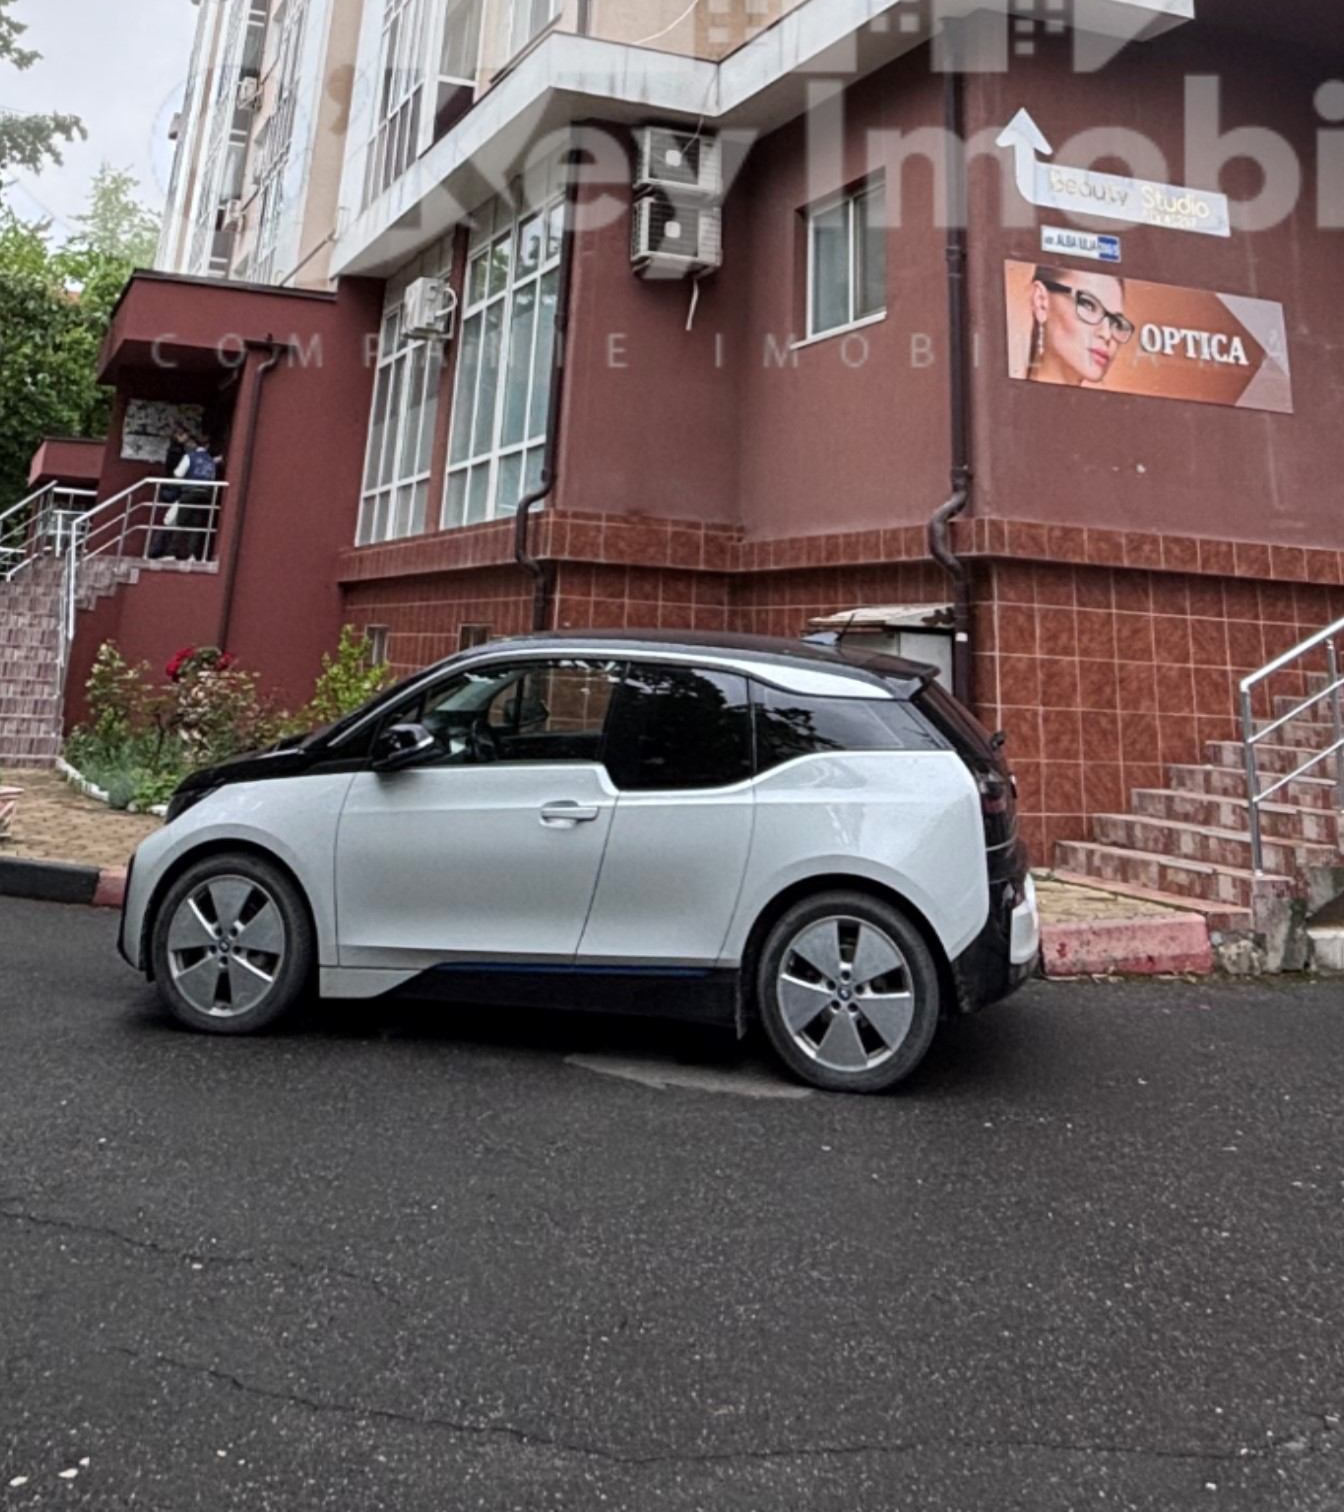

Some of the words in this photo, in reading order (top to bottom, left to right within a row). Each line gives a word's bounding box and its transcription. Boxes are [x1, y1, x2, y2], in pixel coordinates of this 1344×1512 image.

[1050, 167, 1129, 208] Beauty
[1141, 185, 1210, 219] Studio
[1140, 322, 1250, 367] OPTICA
